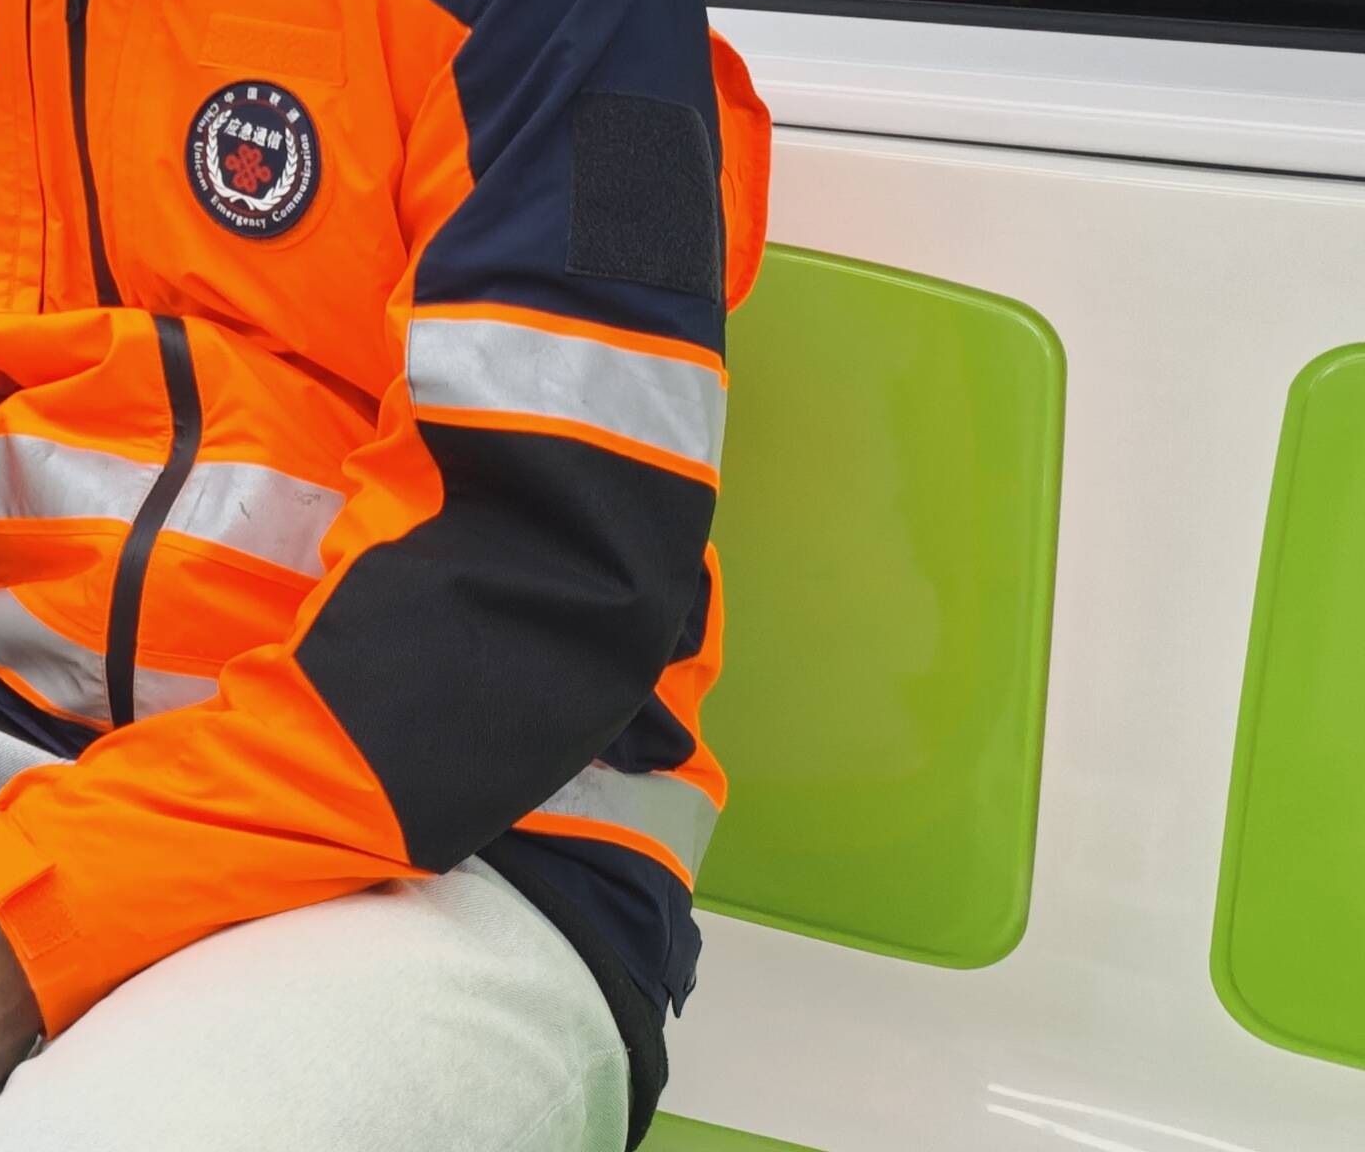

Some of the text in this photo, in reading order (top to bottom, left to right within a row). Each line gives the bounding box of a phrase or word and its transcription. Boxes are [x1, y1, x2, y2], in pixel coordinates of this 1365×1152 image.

[223, 118, 283, 150] 应急通信
[193, 141, 209, 191] Unicom
[210, 194, 267, 229] Emergency
[272, 133, 311, 223] Communication
